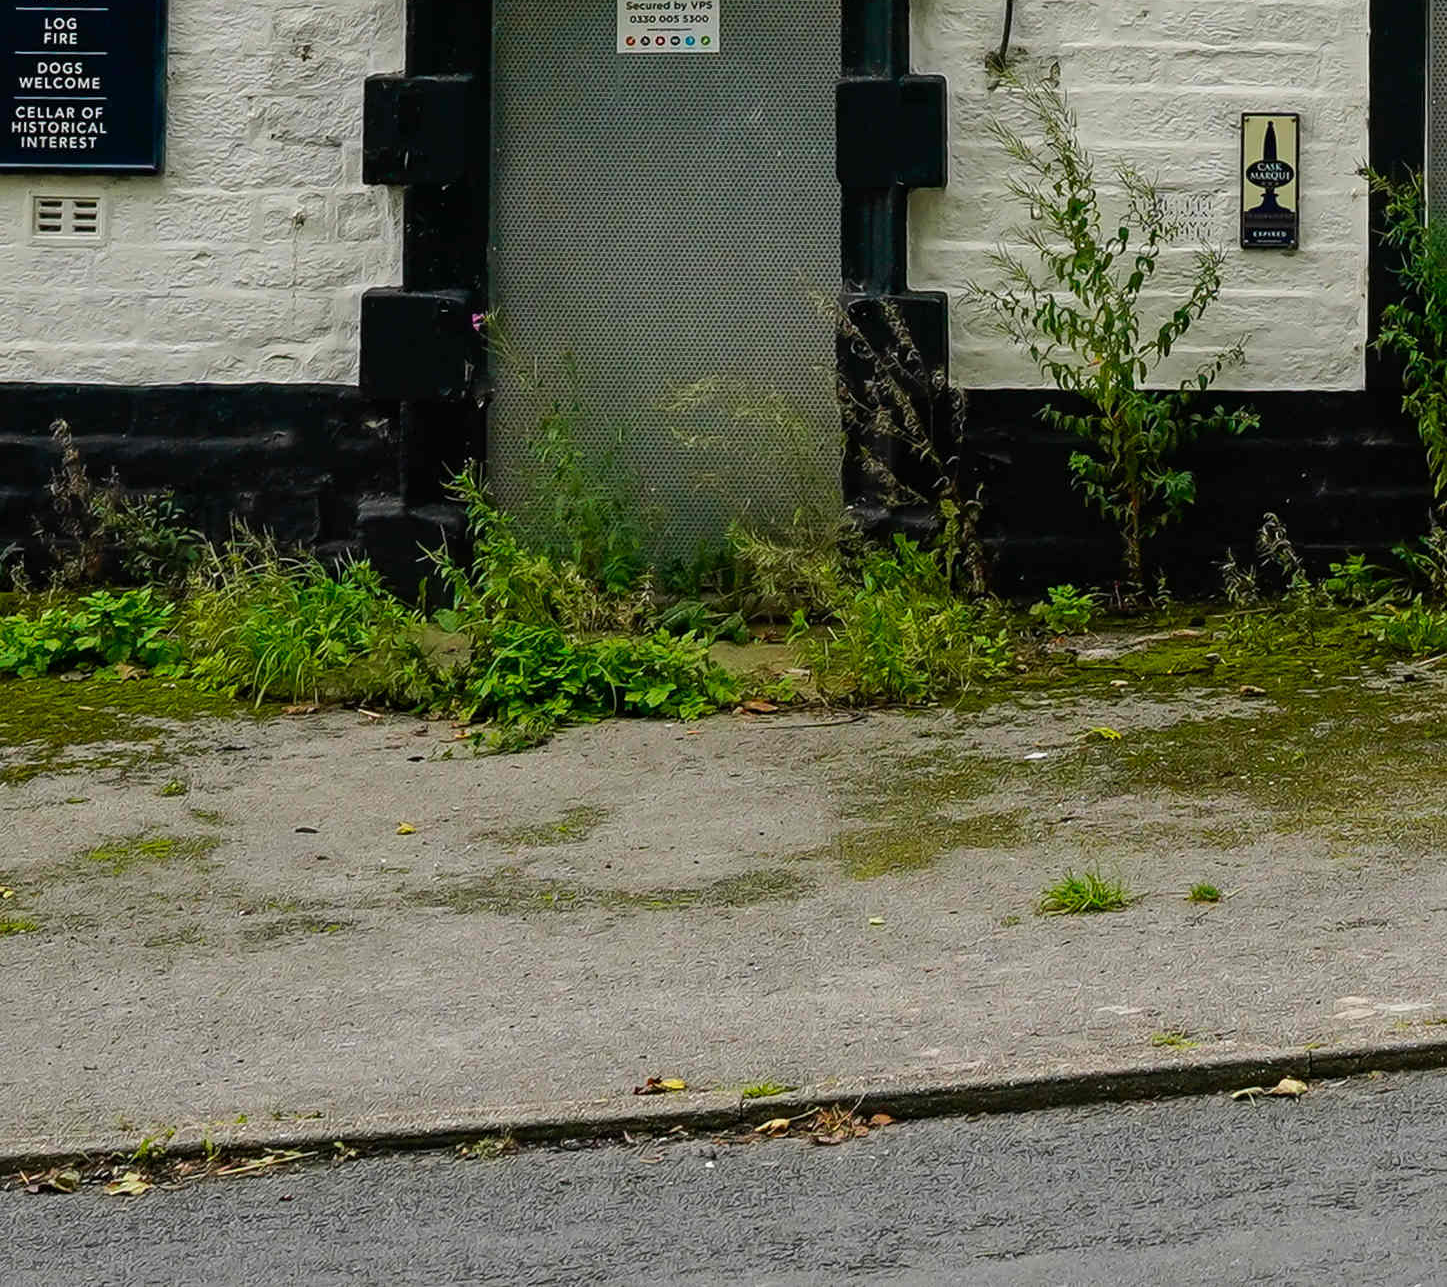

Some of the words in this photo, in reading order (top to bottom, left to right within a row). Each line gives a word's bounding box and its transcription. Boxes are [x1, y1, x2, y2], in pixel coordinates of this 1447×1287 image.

[626, 1, 671, 11] Secured
[674, 1, 688, 11] by
[690, 0, 713, 10] VPS
[44, 17, 78, 30] LOG
[630, 15, 657, 24] 0330
[659, 15, 680, 24] 005
[683, 15, 709, 23] 5300
[43, 32, 78, 45] FIRE
[37, 62, 83, 74] DOGS
[19, 77, 101, 89] WELCOME
[15, 106, 75, 119] CELLAR
[81, 107, 104, 119] OF
[11, 121, 108, 134] HISTORICAL
[21, 136, 98, 149] INTEREST
[1257, 162, 1282, 172] CASK
